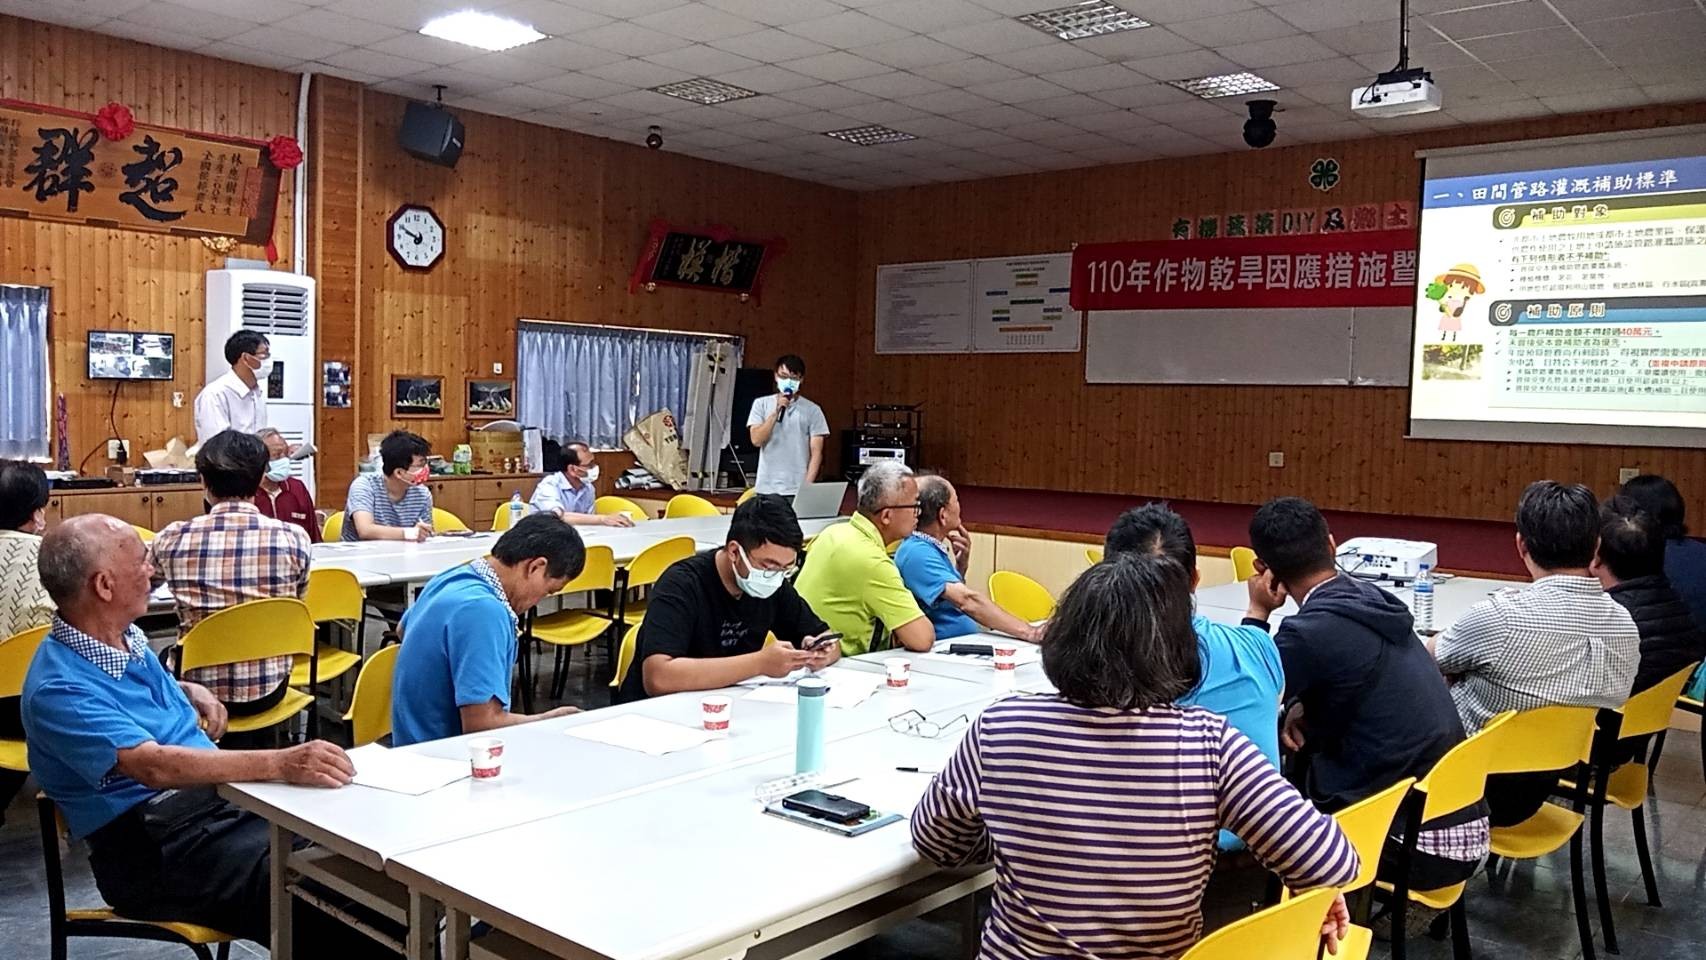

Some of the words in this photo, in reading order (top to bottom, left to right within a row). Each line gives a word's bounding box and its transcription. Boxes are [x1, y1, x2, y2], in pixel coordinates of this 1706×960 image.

[1432, 169, 1678, 201] 一、田間管路灌溉補助標準
[1530, 203, 1609, 223] 補助對象
[1087, 249, 1416, 294] 110年作物乾旱因應措施暨
[1526, 303, 1606, 319] 補助原則
